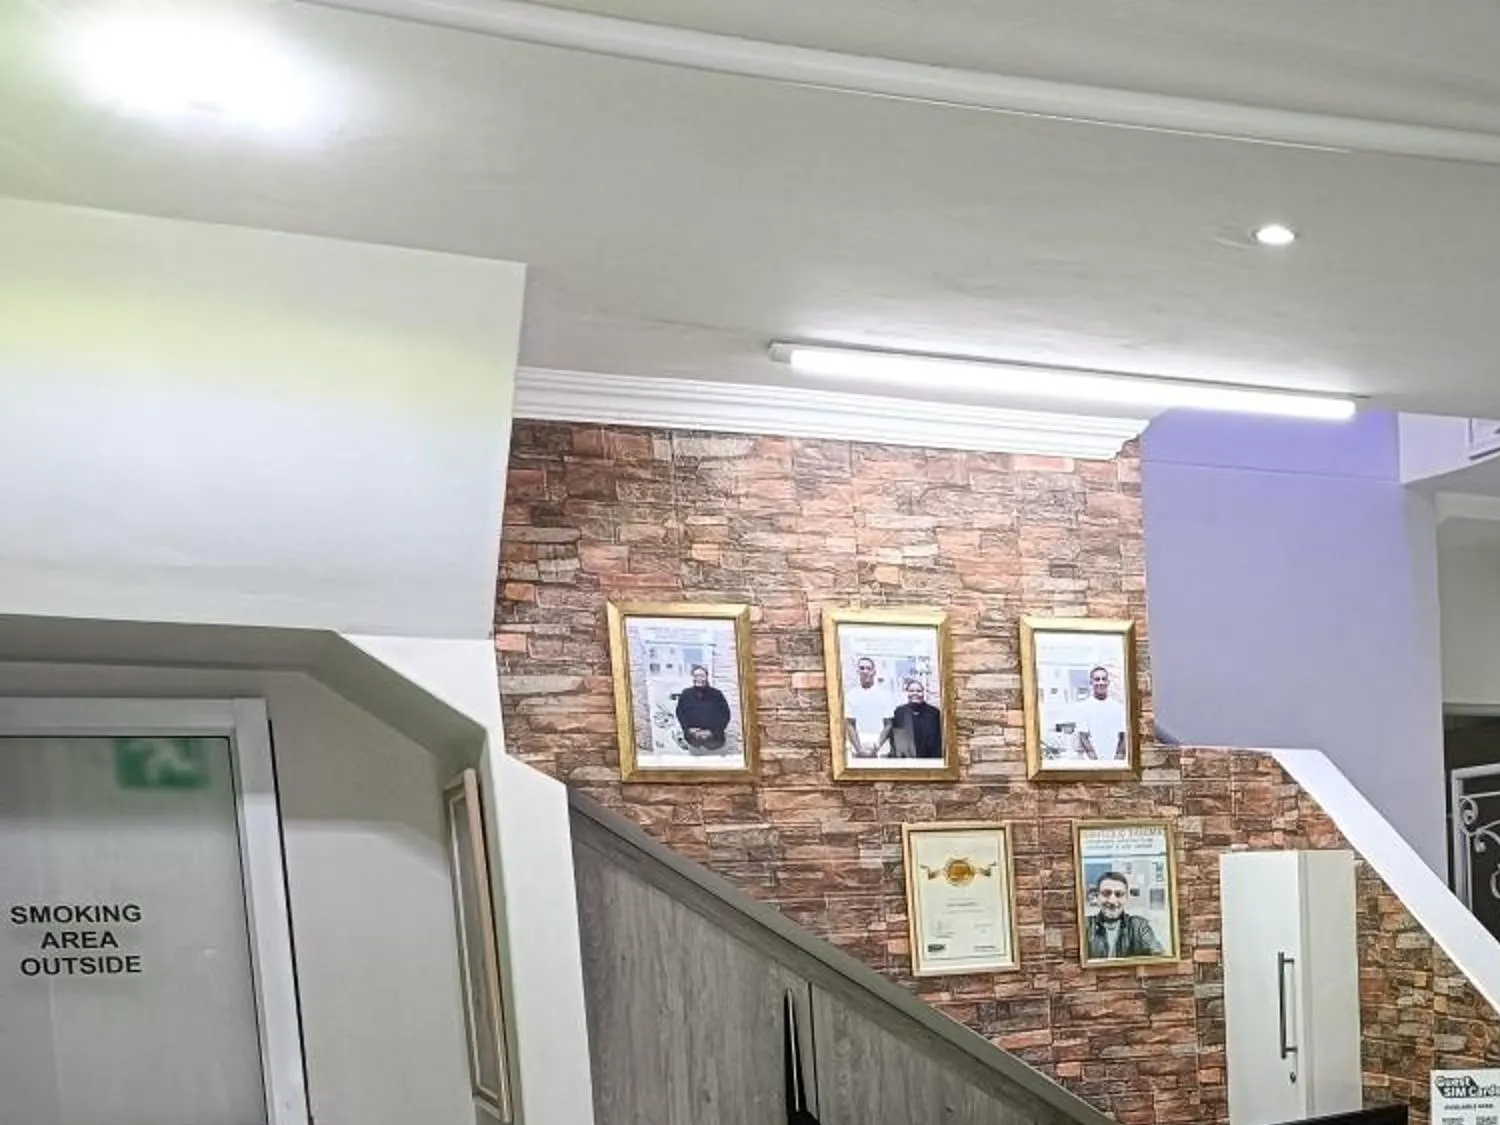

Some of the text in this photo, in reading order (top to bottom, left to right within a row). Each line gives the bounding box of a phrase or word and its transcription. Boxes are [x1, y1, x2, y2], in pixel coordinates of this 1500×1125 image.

[10, 904, 142, 924] SMOKING
[41, 930, 119, 950] AREA
[20, 955, 142, 976] OUTSIDE
